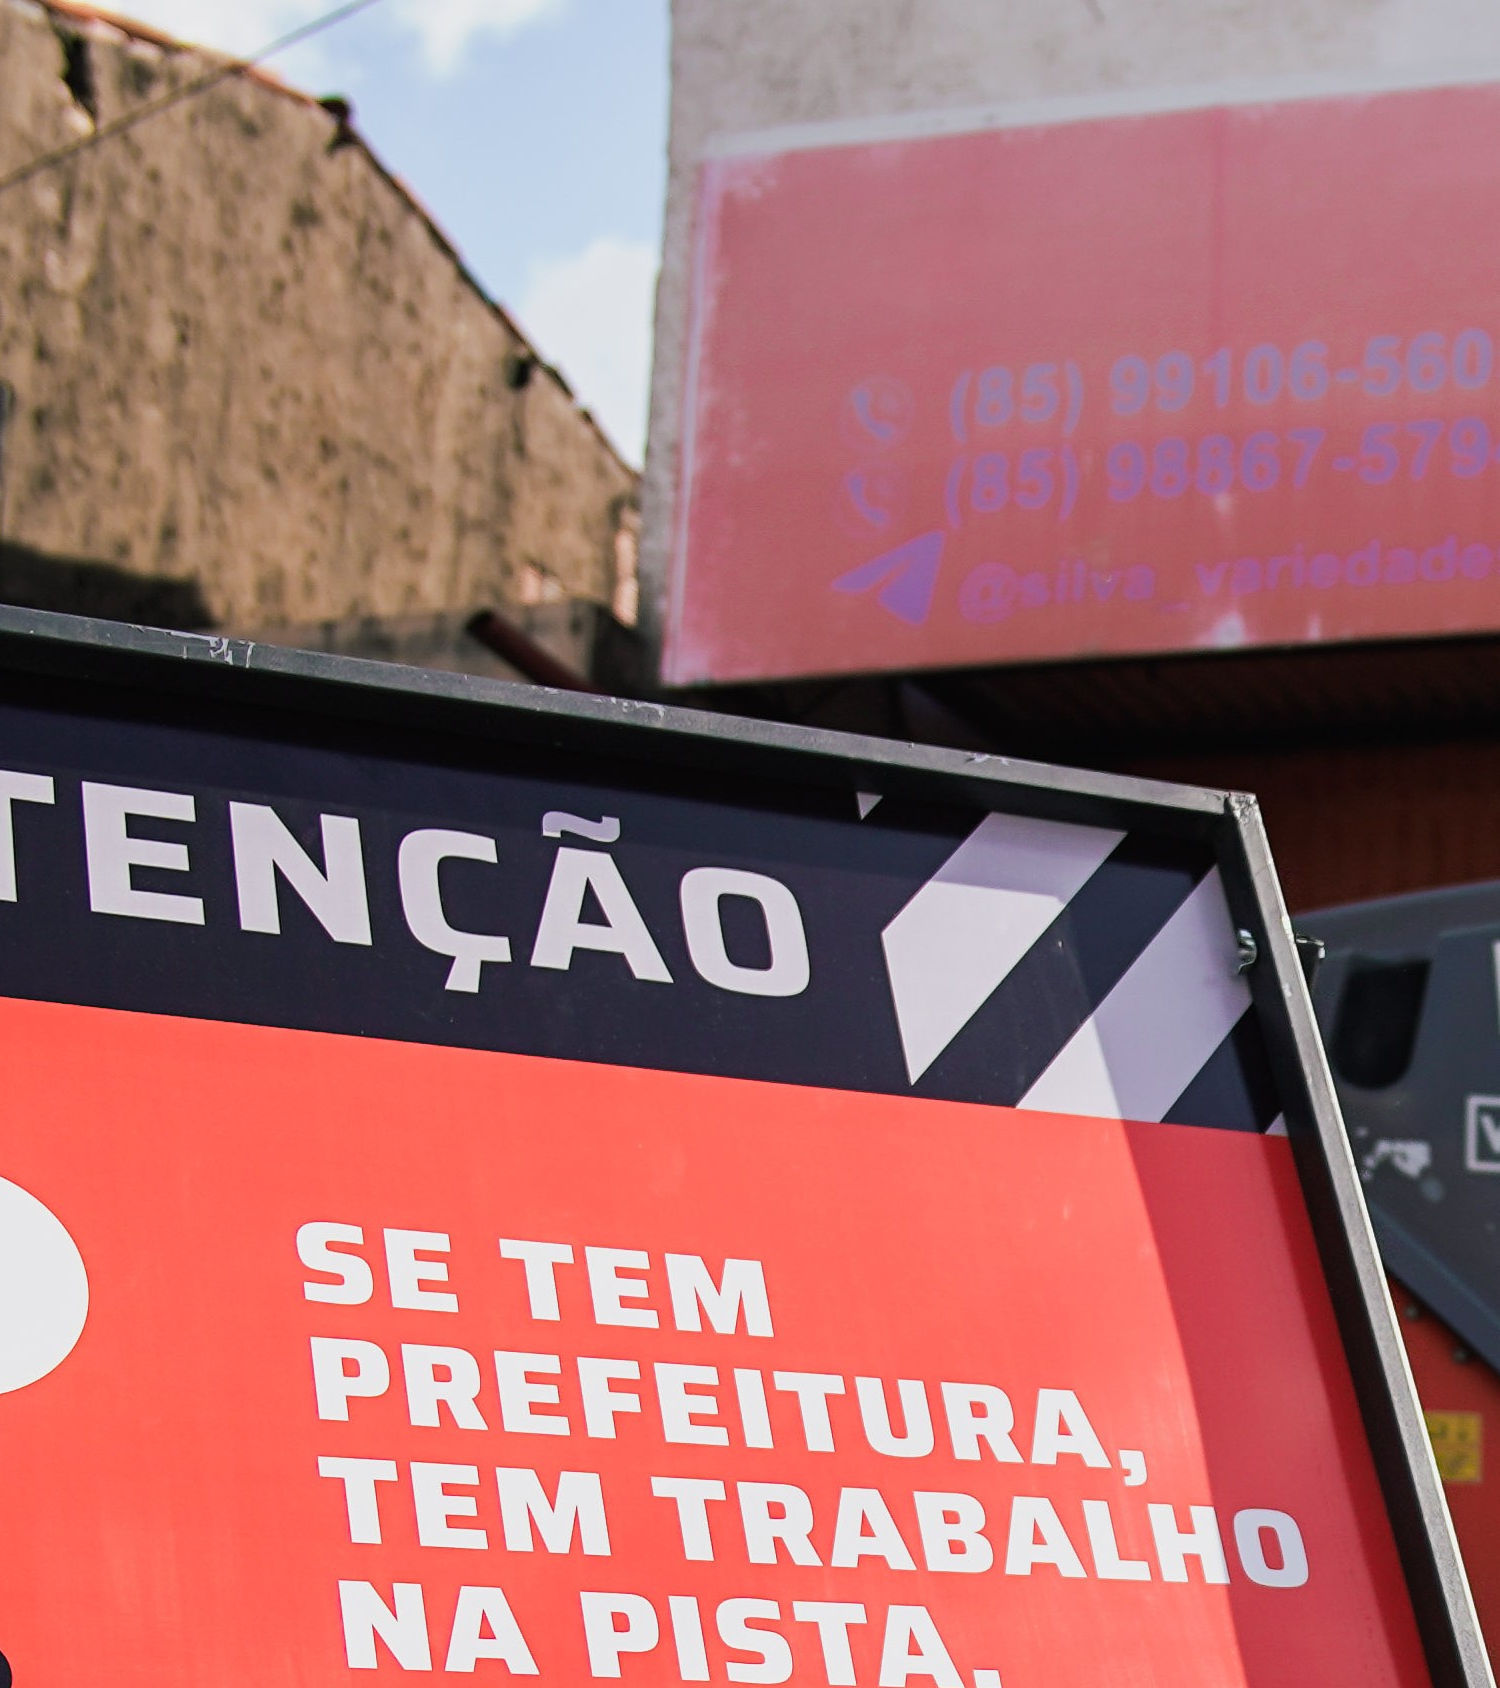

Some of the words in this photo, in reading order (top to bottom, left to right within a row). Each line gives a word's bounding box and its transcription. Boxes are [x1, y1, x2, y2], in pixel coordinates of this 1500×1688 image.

[950, 360, 1085, 442] (85)
[944, 446, 1081, 529] (85)
[296, 1221, 459, 1313] SE
[498, 1238, 775, 1337] TEM
[309, 1336, 1148, 1487] PREFEITURA,
[317, 1455, 612, 1557] TEM
[649, 1475, 1309, 1588] TRABALHO
[338, 1579, 540, 1676] NA
